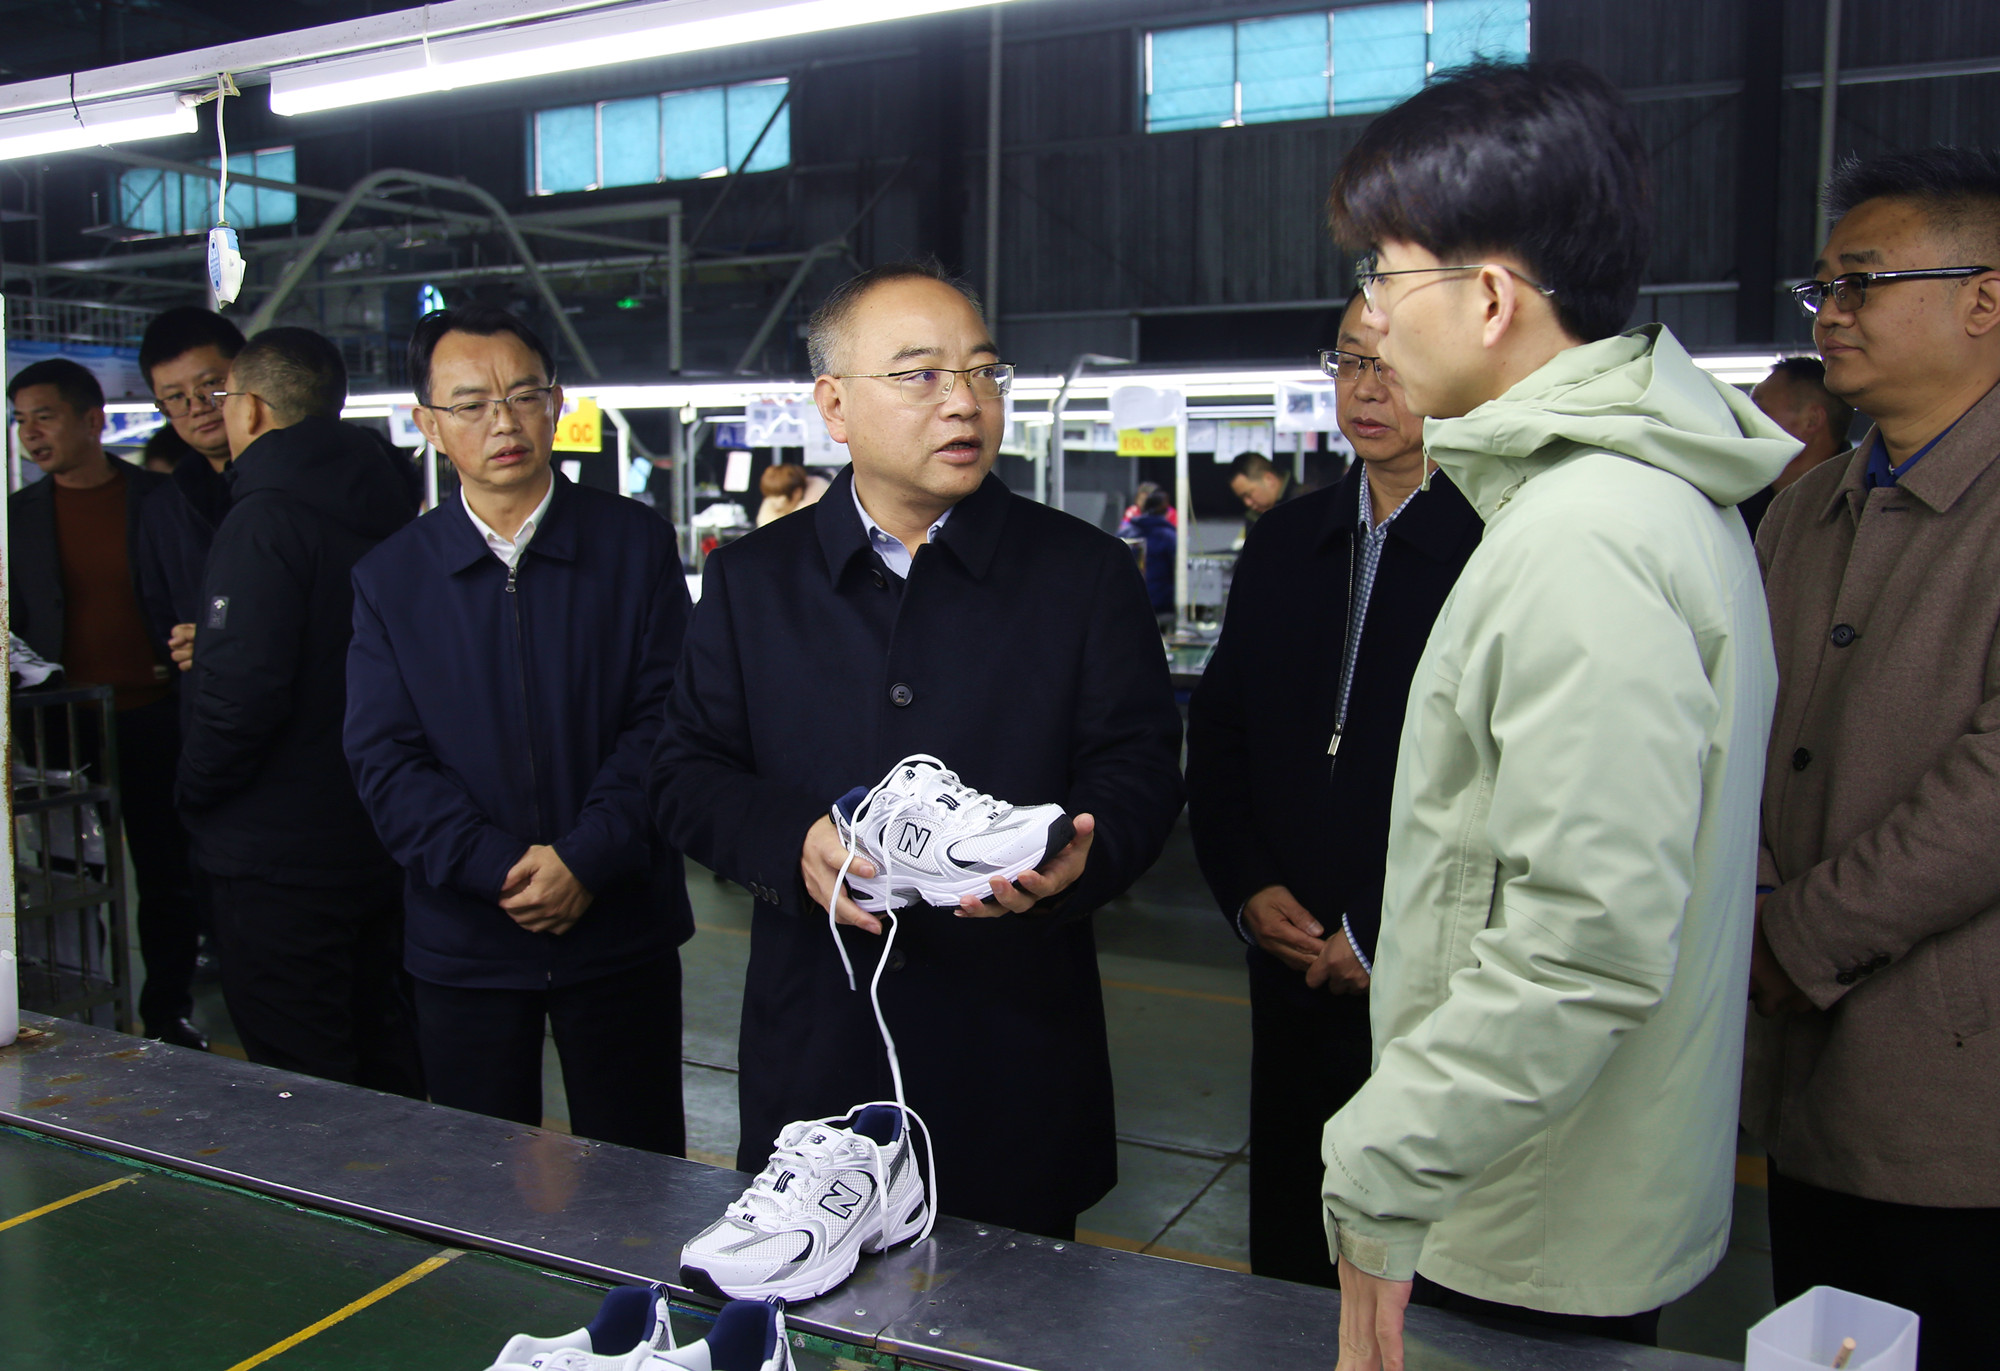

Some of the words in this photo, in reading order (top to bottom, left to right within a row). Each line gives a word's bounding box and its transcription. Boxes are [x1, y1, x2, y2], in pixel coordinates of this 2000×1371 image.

[569, 423, 593, 443] QC
[1151, 436, 1170, 451] QC
[897, 821, 932, 859] N
[818, 1179, 862, 1219] N
